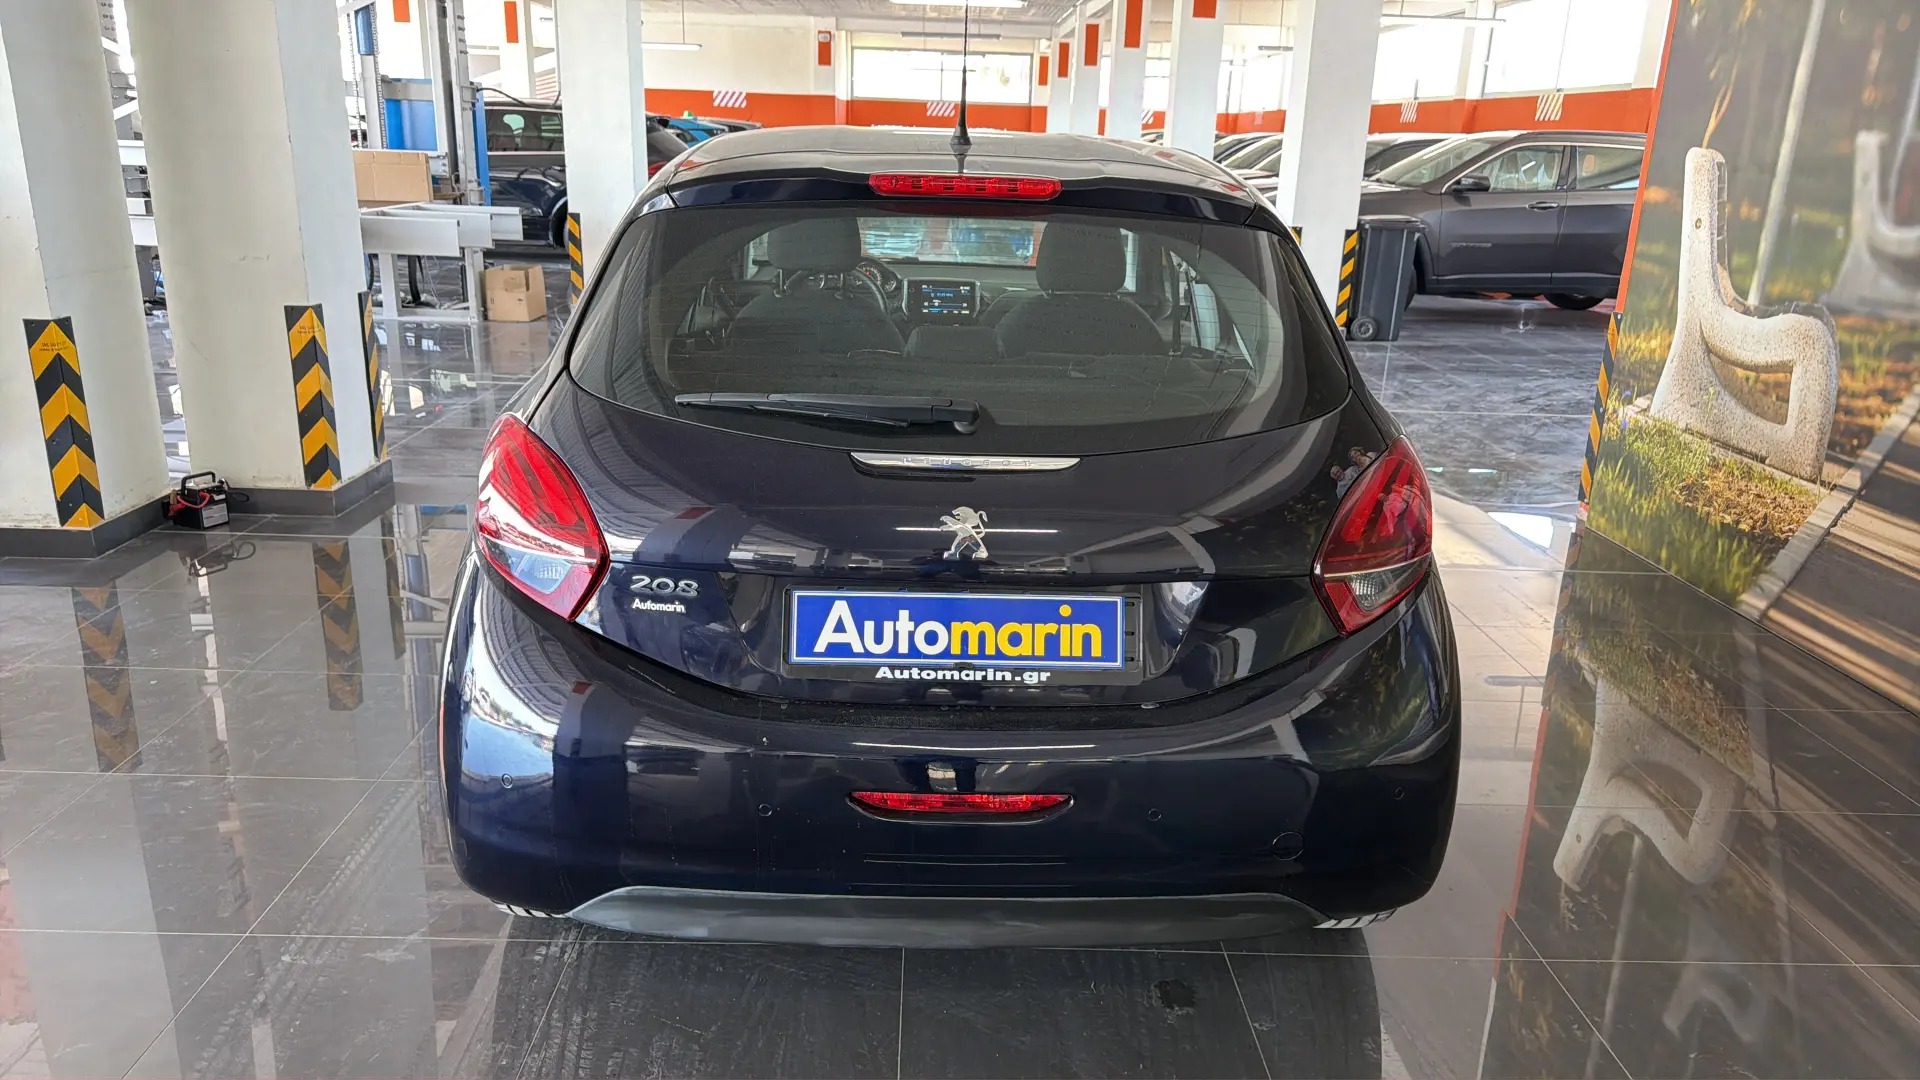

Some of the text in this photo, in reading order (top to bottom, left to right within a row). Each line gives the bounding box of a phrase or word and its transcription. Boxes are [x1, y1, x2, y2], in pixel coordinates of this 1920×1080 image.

[903, 457, 1032, 467] PEUGEOT
[630, 575, 699, 597] 208
[632, 598, 686, 613] Automarin
[813, 599, 1102, 657] Automarin
[875, 666, 1051, 683] Automarin.gr
